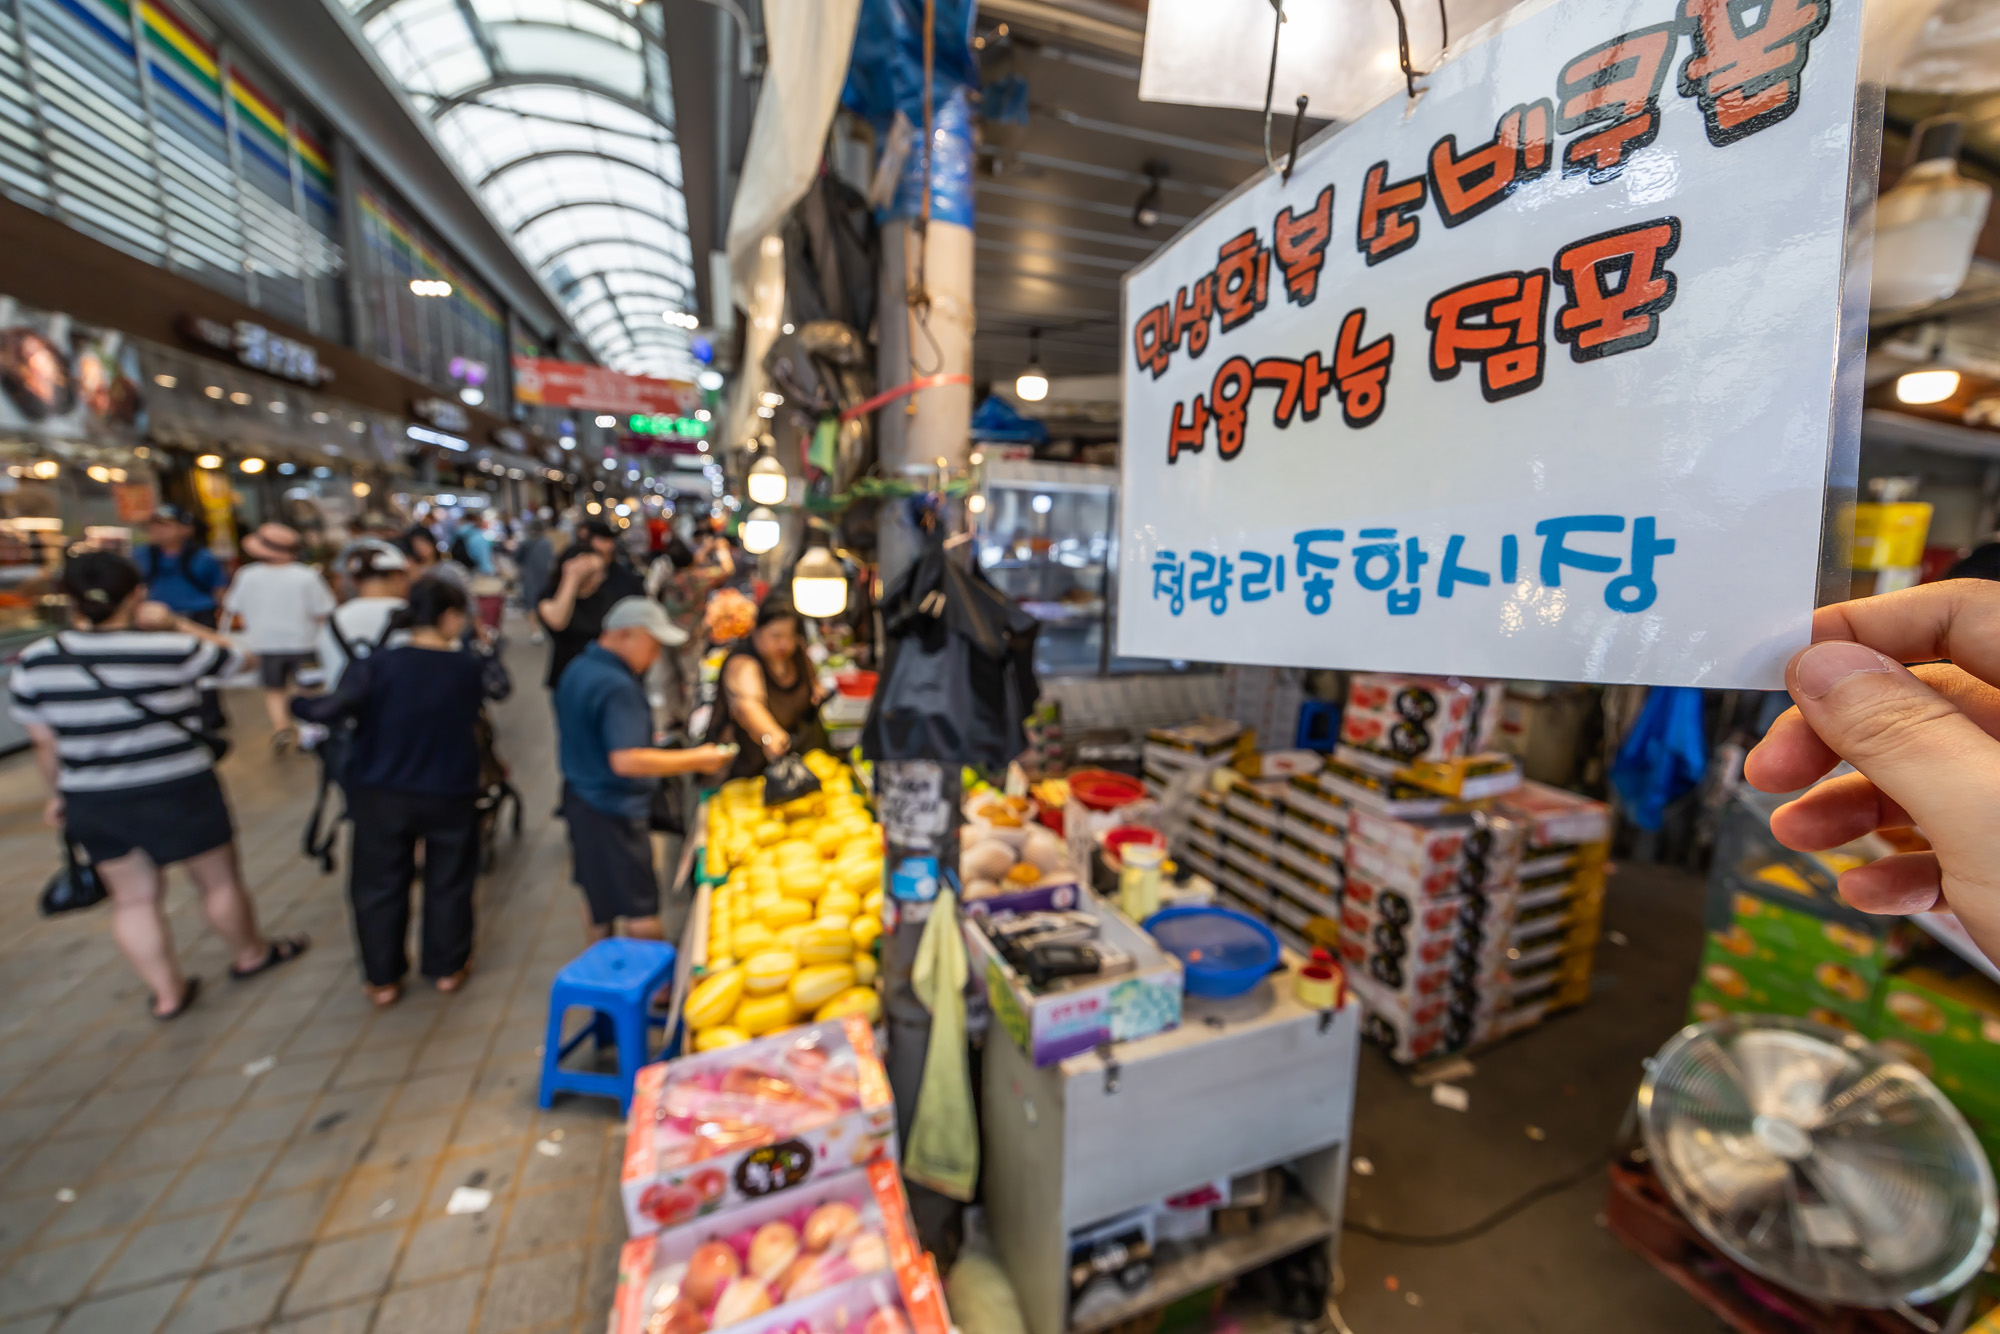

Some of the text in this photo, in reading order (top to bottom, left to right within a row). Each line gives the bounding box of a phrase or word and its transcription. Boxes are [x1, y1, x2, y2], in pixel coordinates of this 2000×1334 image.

[1135, 0, 1831, 382] 민생회복 소비쿠폰
[1167, 215, 1682, 465] 사용가능 점포
[1152, 515, 1676, 616] 청량리종합시장
